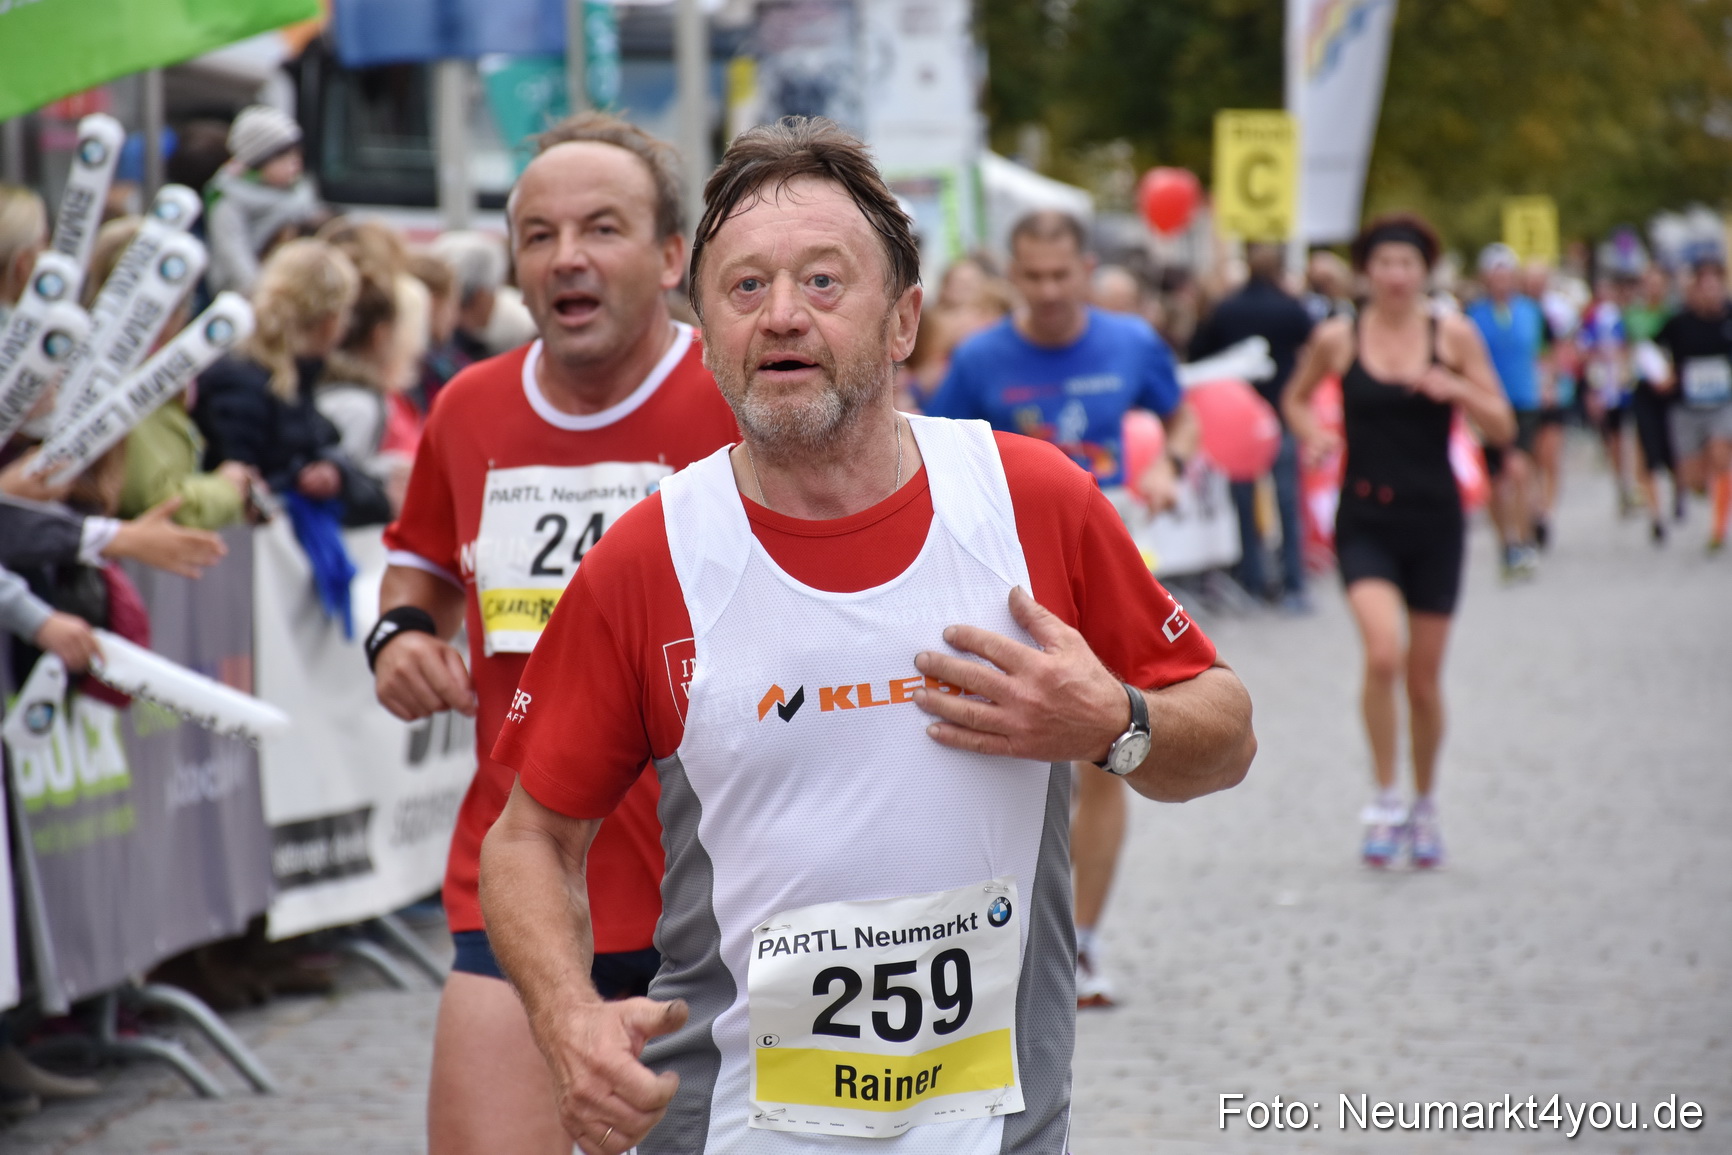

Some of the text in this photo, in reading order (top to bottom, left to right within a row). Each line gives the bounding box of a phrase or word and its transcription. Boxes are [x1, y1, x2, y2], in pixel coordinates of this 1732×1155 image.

[1235, 148, 1282, 211] C
[489, 484, 637, 505] PARTL Neumarkt
[757, 912, 979, 960] PARTL Neumarkt
[811, 947, 974, 1043] 259
[834, 1062, 943, 1102] Rainer
